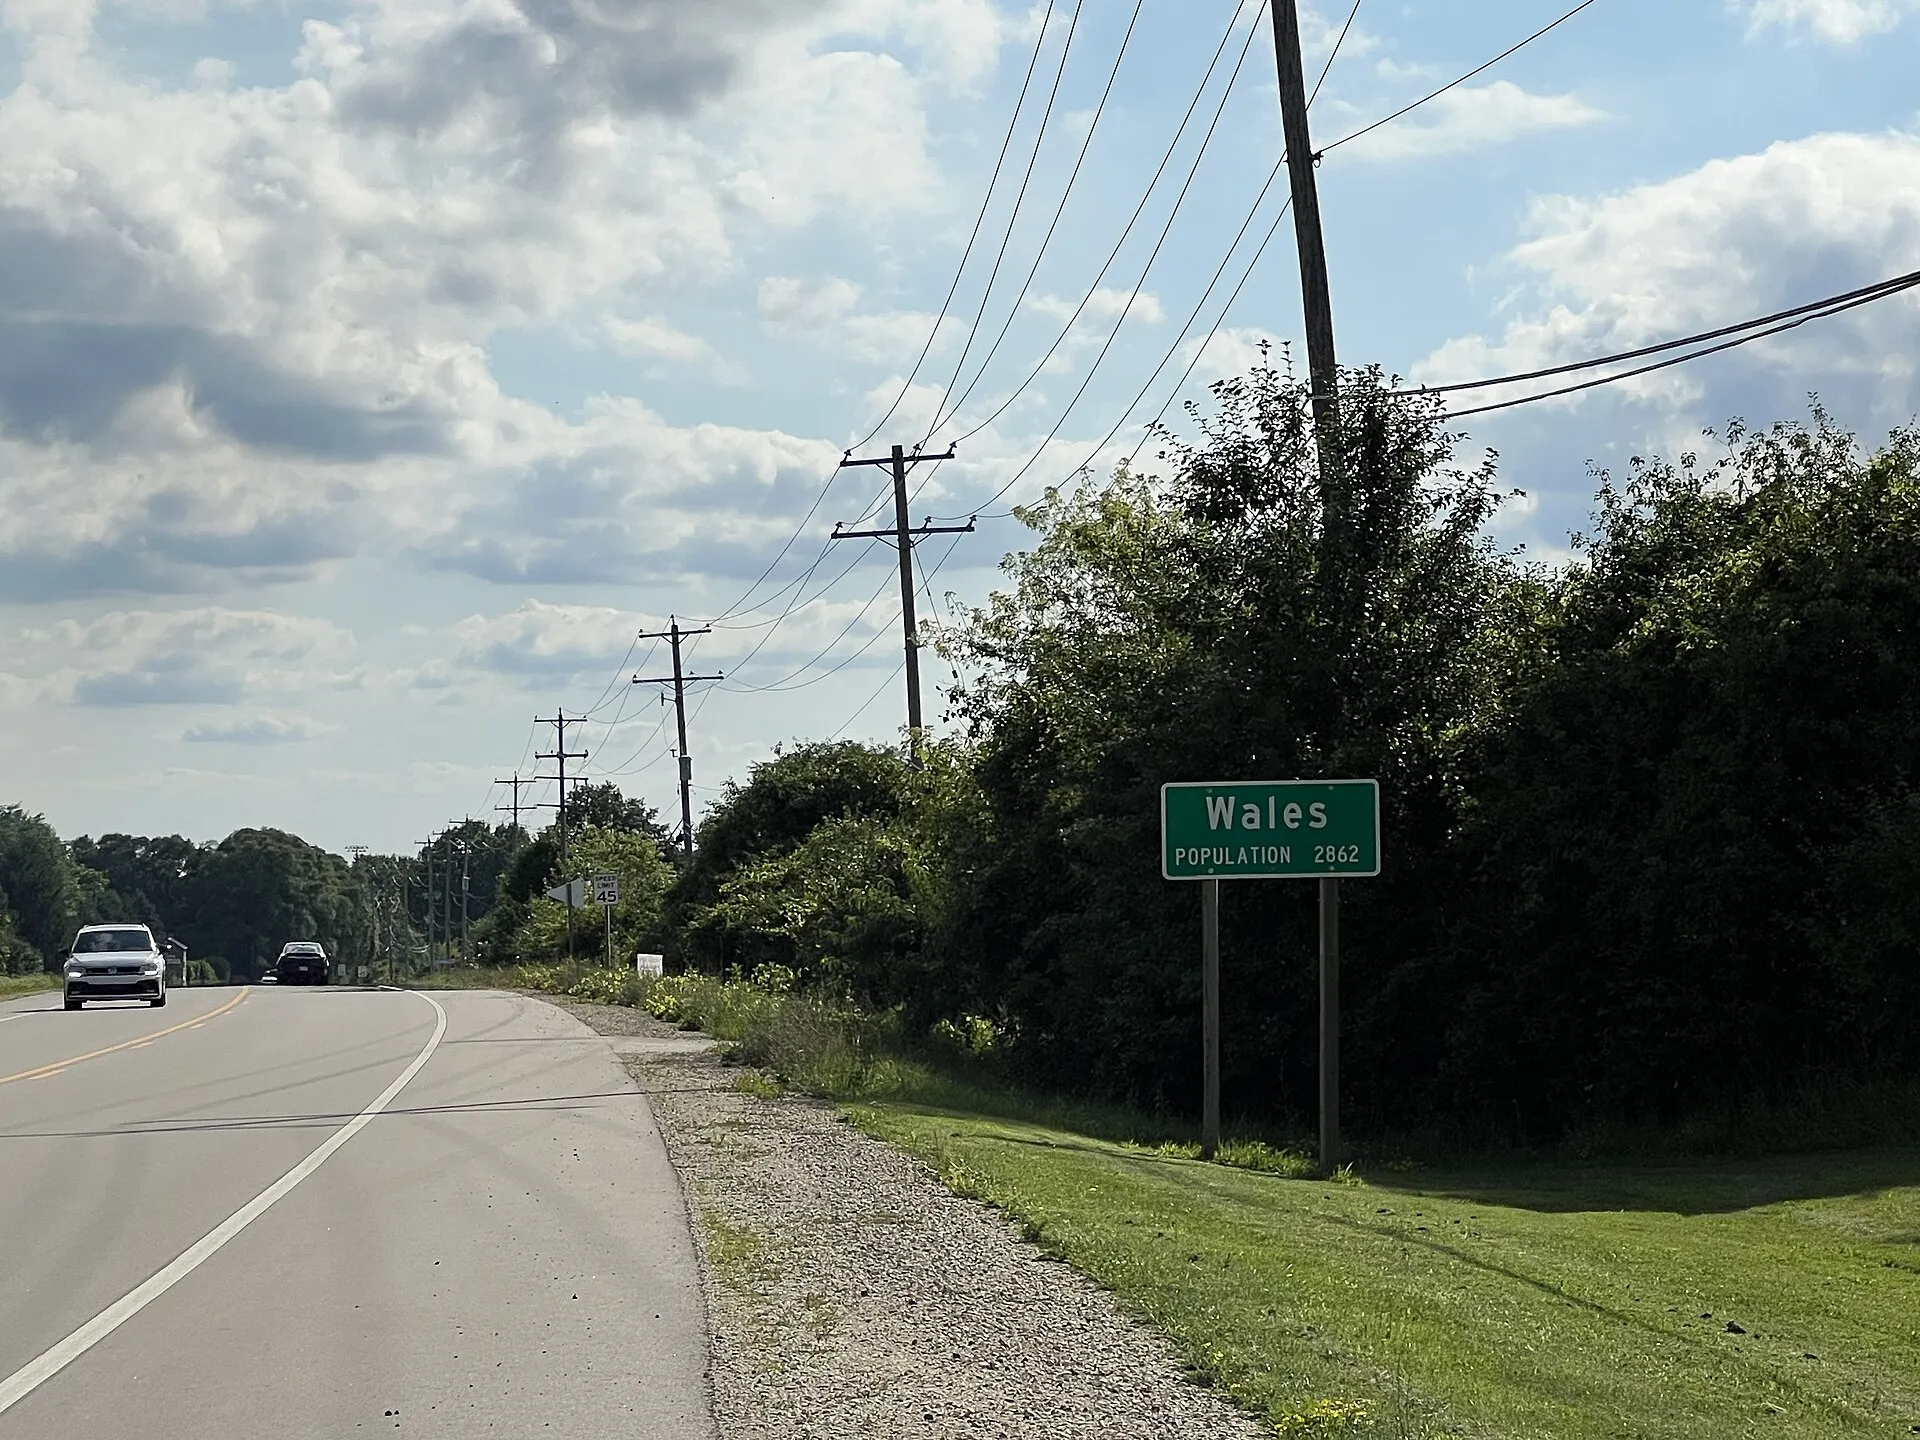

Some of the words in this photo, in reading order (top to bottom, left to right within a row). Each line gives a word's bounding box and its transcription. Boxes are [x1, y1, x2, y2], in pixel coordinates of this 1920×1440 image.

[1206, 796, 1328, 830] Wales
[1175, 846, 1291, 866] POPULATION
[1314, 845, 1359, 863] 2862
[596, 890, 616, 902] 45
